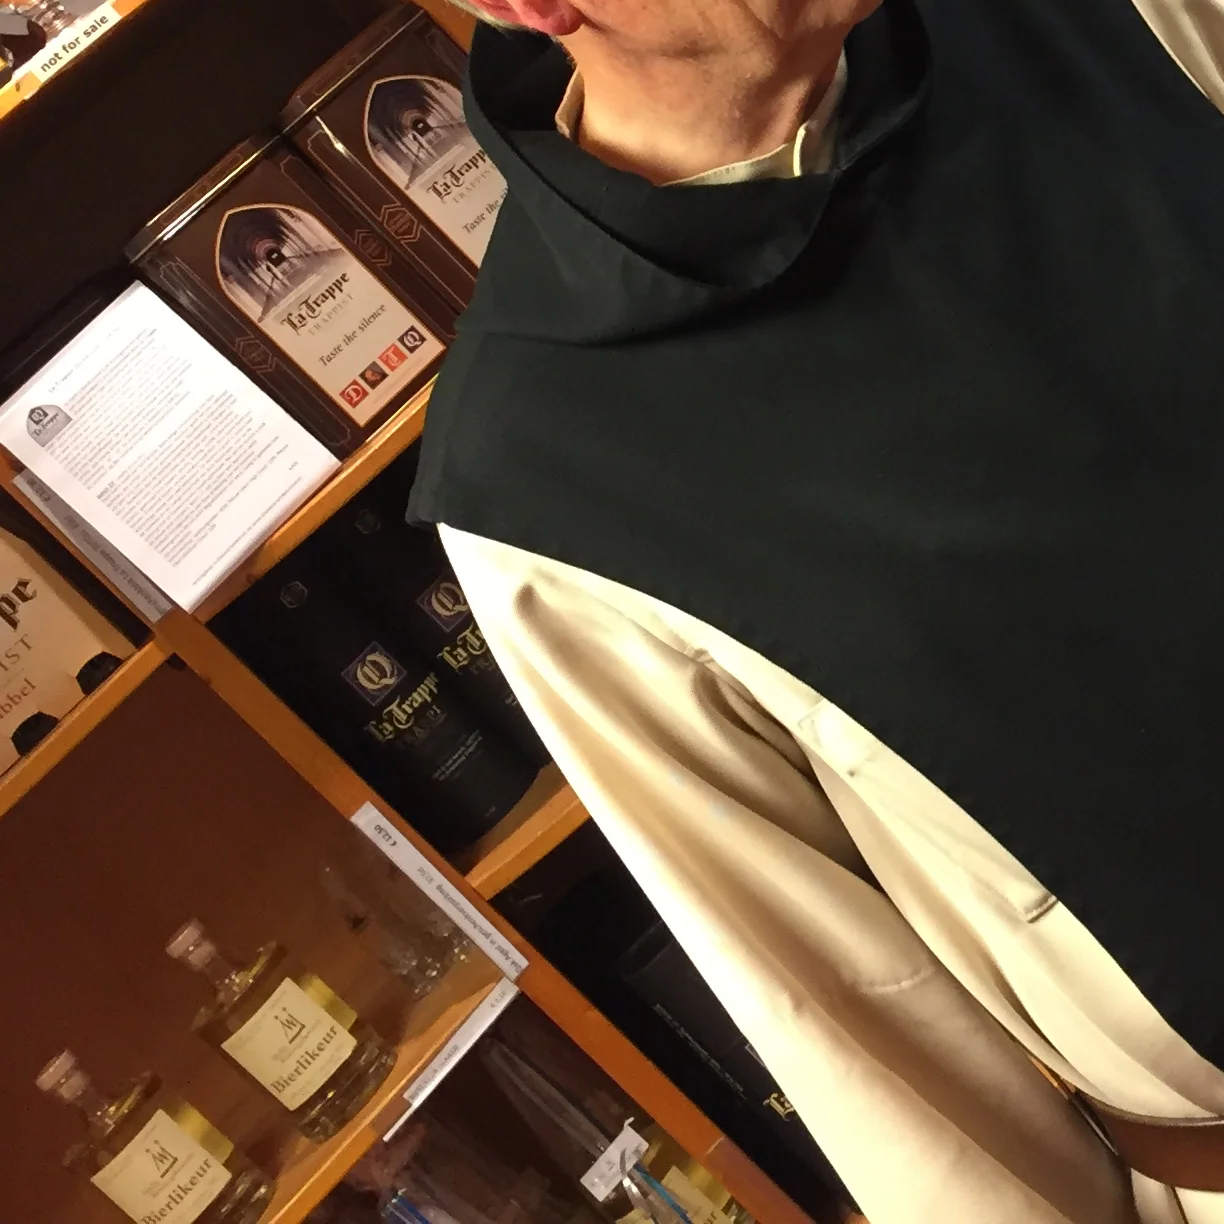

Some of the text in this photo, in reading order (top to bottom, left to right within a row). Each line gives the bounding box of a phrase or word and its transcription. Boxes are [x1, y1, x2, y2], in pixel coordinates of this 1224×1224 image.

[40, 16, 109, 72] not for sale
[462, 200, 500, 234] Taste the
[318, 303, 387, 367] Taste the silence
[0, 677, 36, 719] bbel
[270, 1025, 338, 1094] Bierlikeur
[140, 1158, 212, 1224] Bierlikeur
